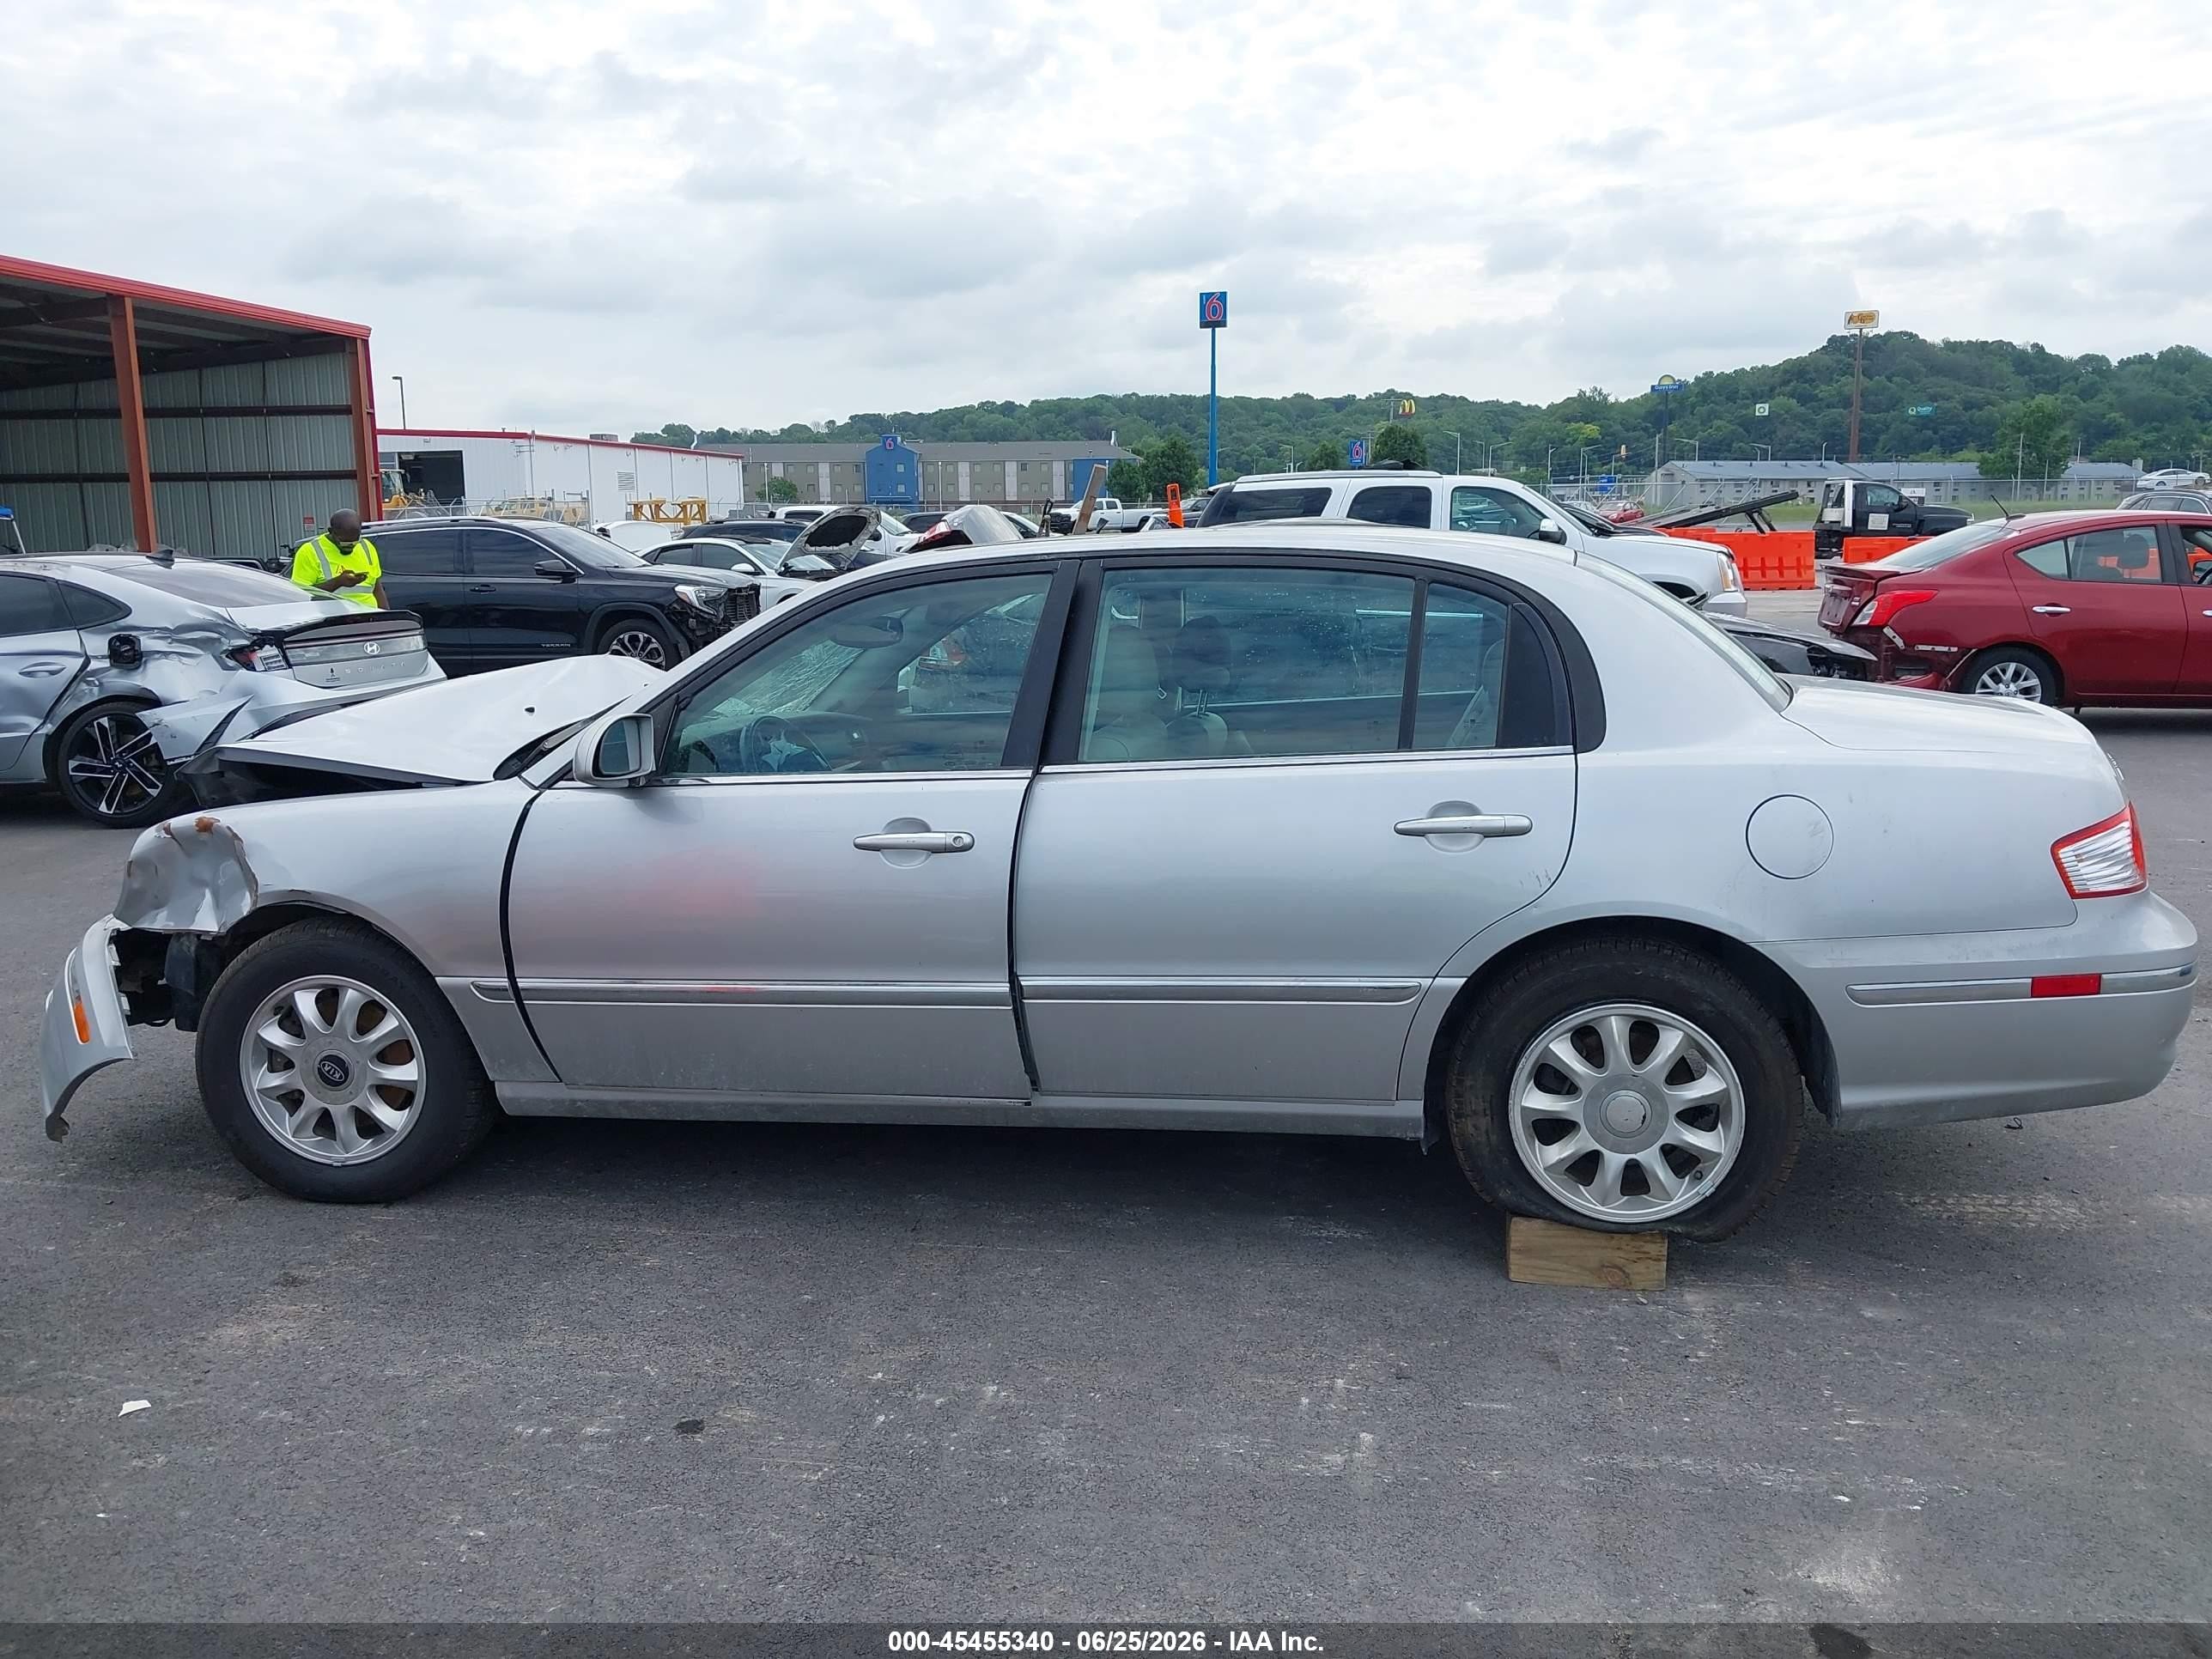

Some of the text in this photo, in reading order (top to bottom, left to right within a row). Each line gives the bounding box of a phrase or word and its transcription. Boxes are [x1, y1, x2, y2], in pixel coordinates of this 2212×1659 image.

[1206, 292, 1223, 320] 6
[1352, 441, 1362, 459] 6
[323, 1063, 342, 1079] KIA
